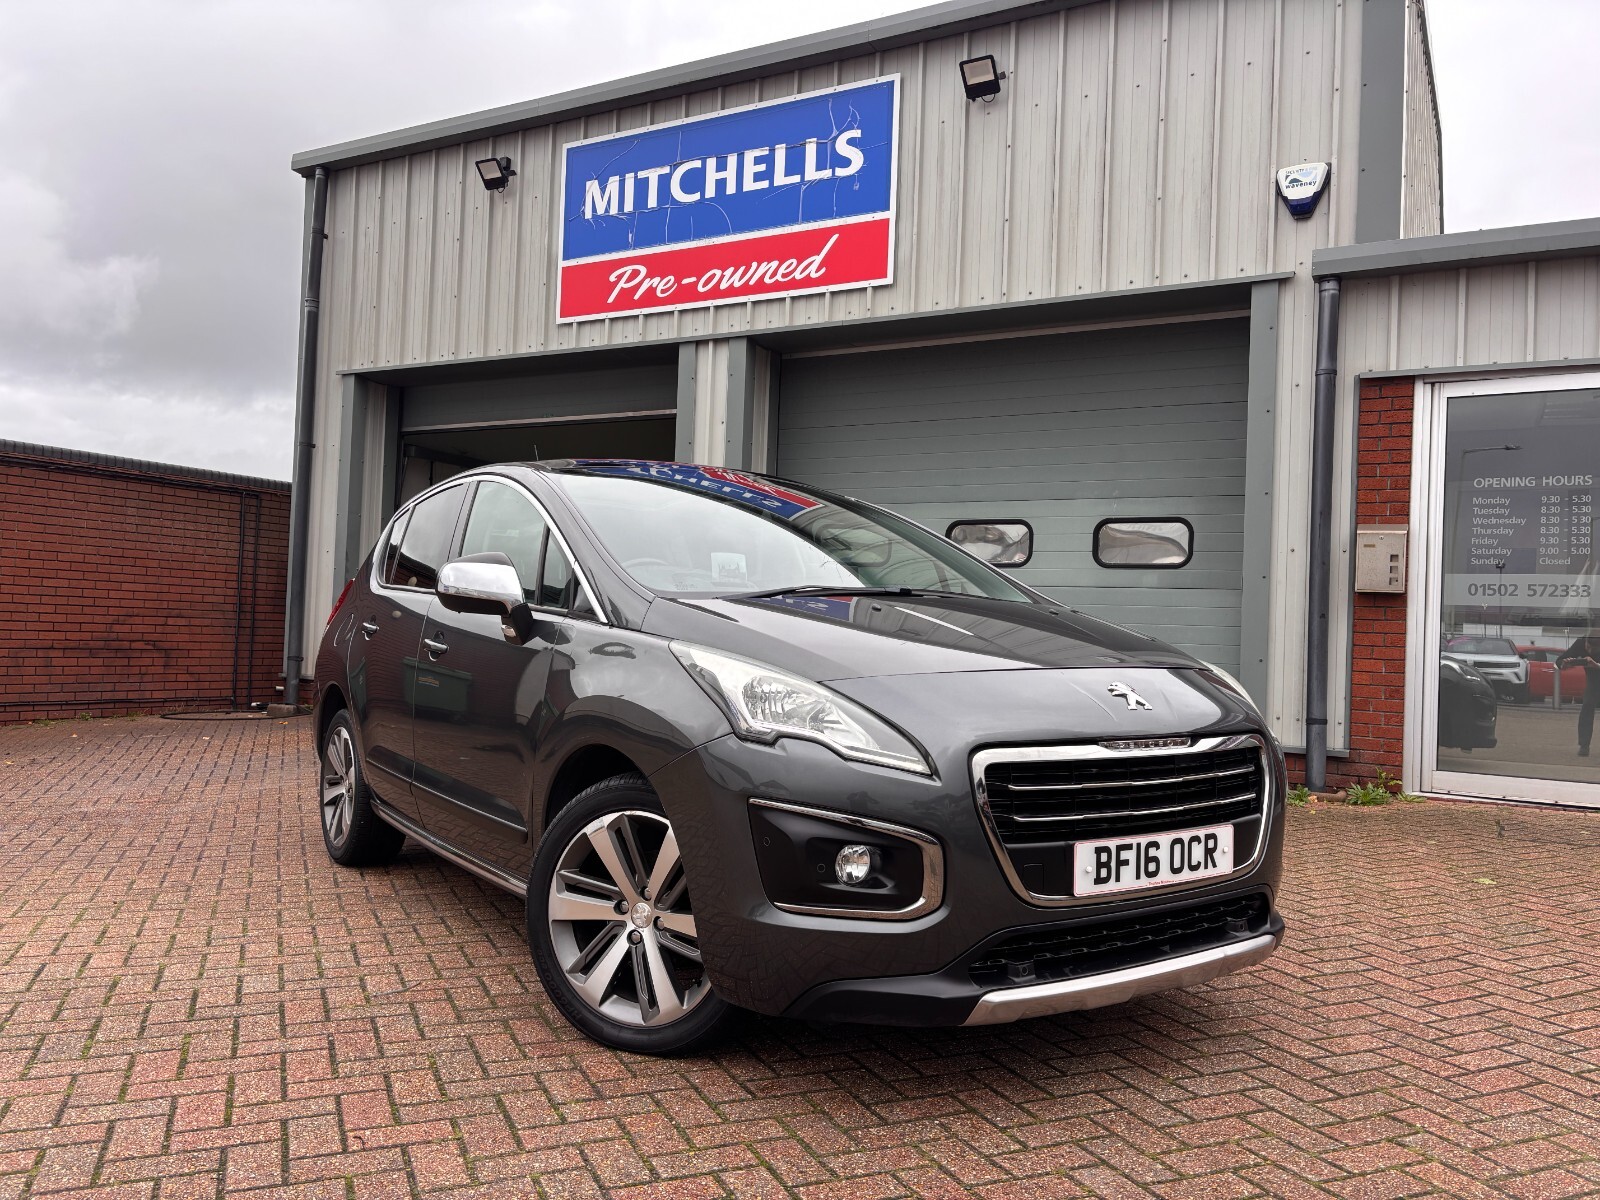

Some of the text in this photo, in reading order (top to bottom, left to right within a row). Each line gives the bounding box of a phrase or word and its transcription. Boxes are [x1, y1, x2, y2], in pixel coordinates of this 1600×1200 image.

[584, 129, 865, 220] MITCHELLS
[1285, 180, 1317, 189] waveney
[606, 233, 840, 304] Pre-owned
[1473, 475, 1593, 488] OPENING HOURS
[1472, 496, 1511, 506] Monday
[1541, 495, 1560, 503] 9.30
[1572, 495, 1592, 503] 5.30
[1472, 506, 1511, 516] Tuesday
[1540, 505, 1560, 513] 8.30
[1572, 505, 1592, 513] 5.30
[1472, 516, 1527, 526] Wednesday
[1540, 516, 1560, 524] 8.30
[1571, 516, 1592, 524] 530
[1472, 526, 1515, 537] Thursday
[1540, 526, 1560, 534] 8.30
[1571, 526, 1591, 534] 5.30
[1471, 536, 1499, 546] Friday
[1540, 536, 1559, 544] 9.30
[1571, 536, 1591, 544] 5.30
[1471, 547, 1512, 557] Saturday
[1539, 547, 1559, 555] 9.00
[1571, 547, 1591, 555] 5.00
[1470, 557, 1571, 566] Sunday Closed
[1467, 583, 1592, 598] 01502 572333
[1093, 832, 1219, 886] BF16 OCR
